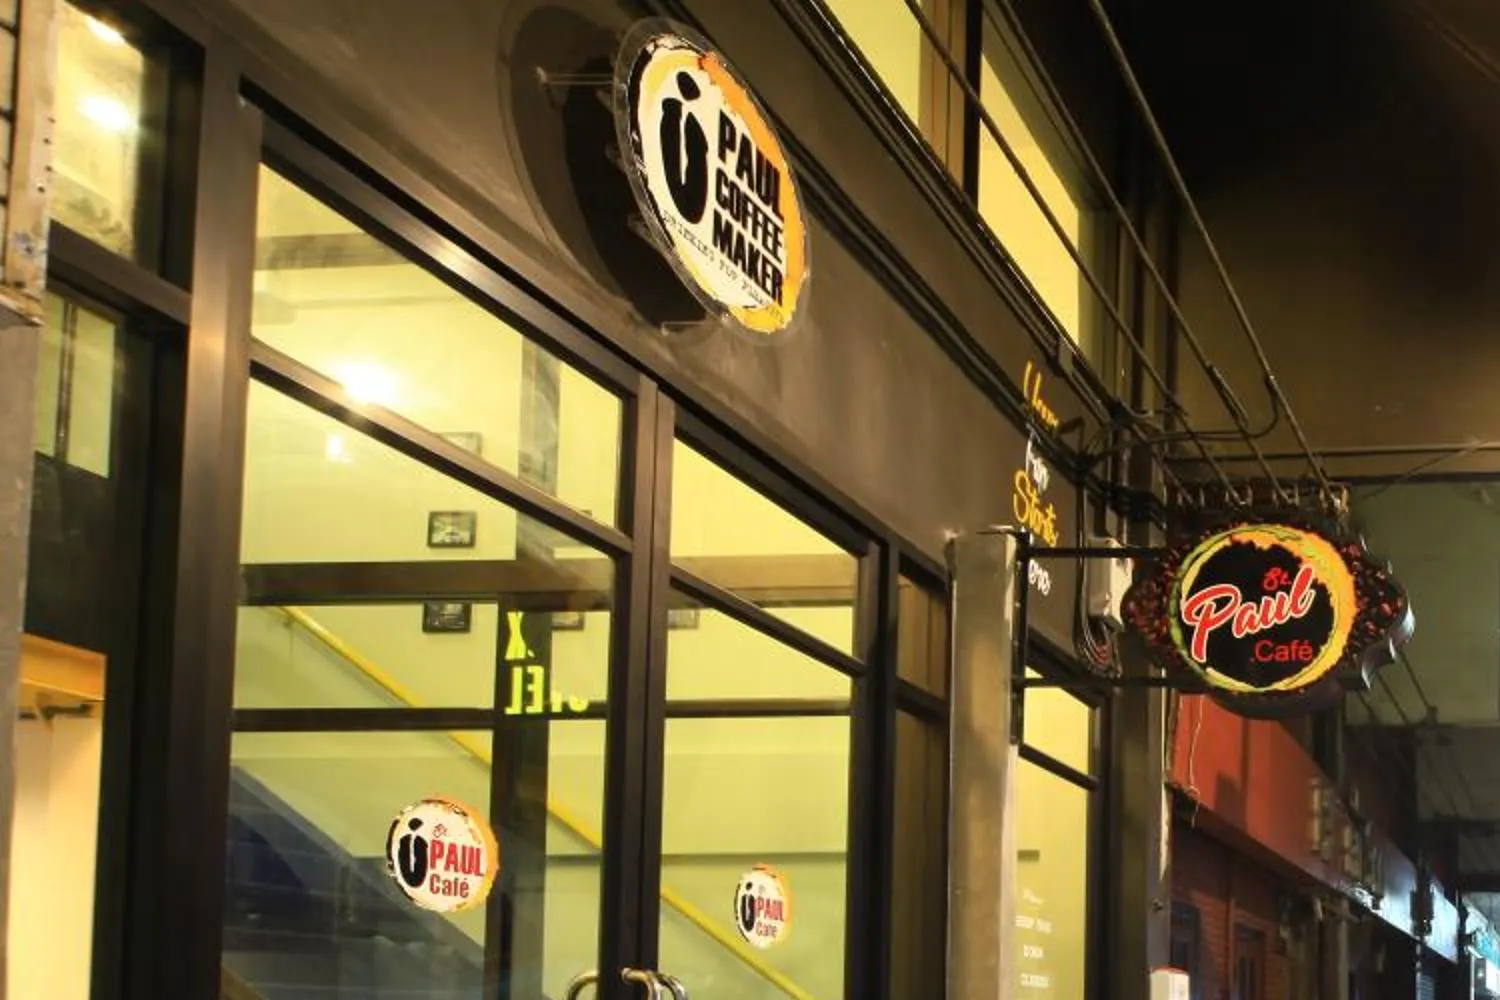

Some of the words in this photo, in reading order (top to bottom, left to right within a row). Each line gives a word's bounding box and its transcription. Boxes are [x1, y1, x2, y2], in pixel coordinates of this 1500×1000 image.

[717, 108, 784, 222] PAUL
[712, 208, 783, 307] MAKER
[714, 167, 783, 264] COFFEE
[1181, 564, 1316, 663] Paul
[1255, 639, 1314, 662] Café
[429, 838, 485, 877] PAUL
